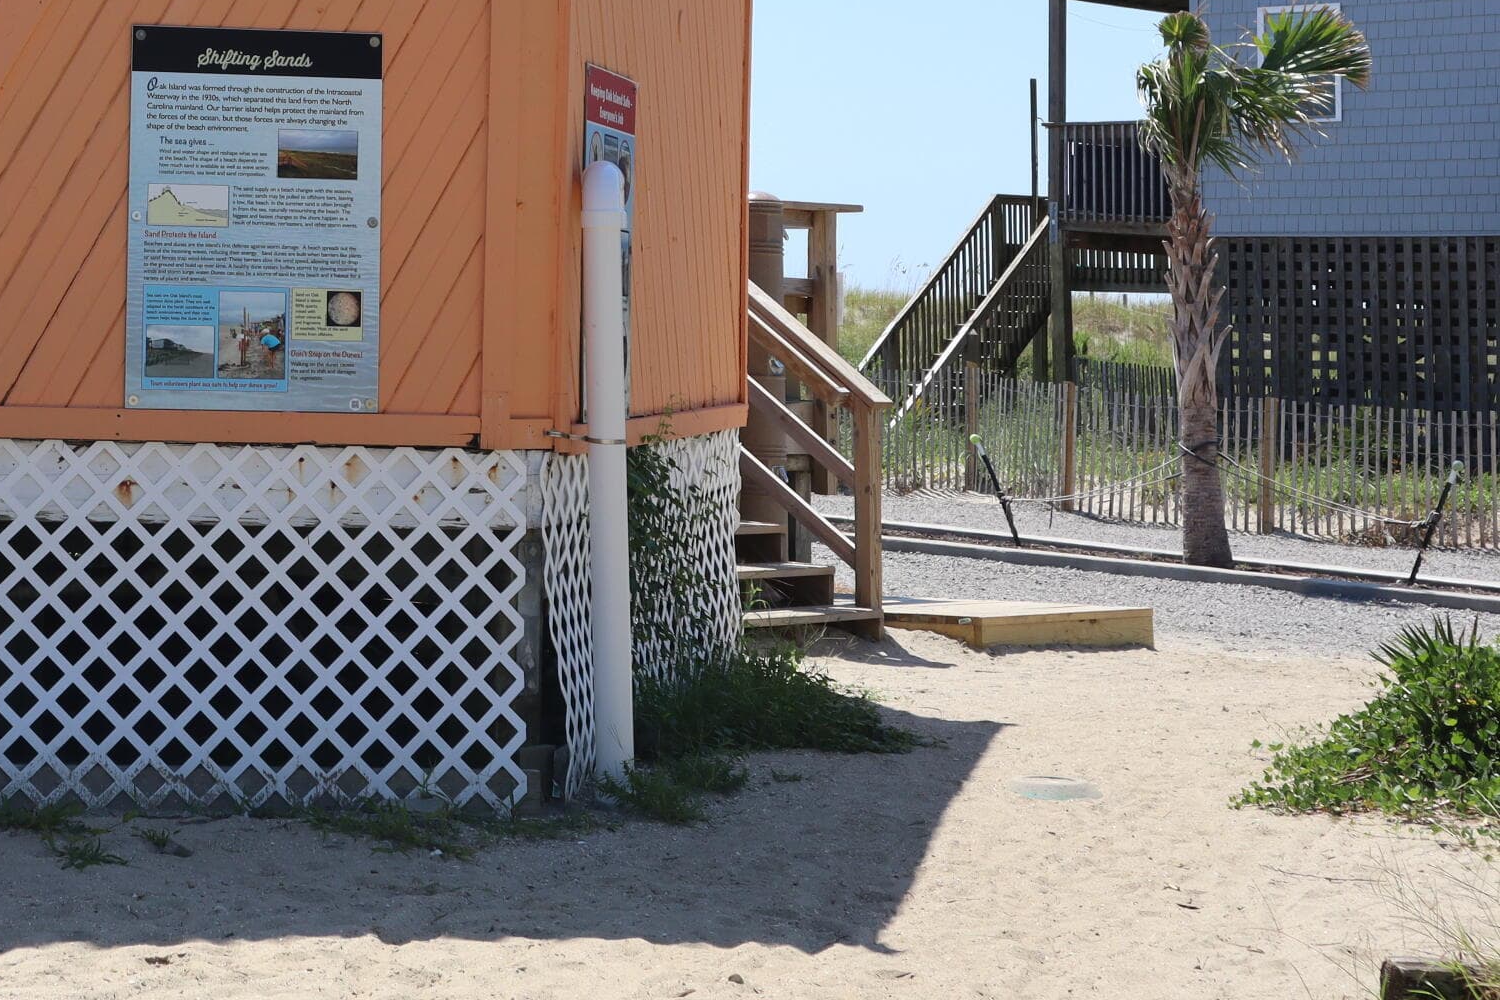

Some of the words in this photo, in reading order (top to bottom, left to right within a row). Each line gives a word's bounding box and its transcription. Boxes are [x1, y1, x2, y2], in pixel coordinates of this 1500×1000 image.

[197, 48, 261, 70] Shifting
[264, 50, 313, 70] Sands
[147, 76, 167, 92] Oak
[168, 82, 187, 90] Island
[202, 83, 226, 92] formed
[228, 84, 252, 94] through
[254, 84, 264, 93] the
[266, 85, 305, 94] construction
[306, 86, 313, 94] of
[314, 86, 325, 94] the
[326, 87, 362, 96] Intracoastal
[147, 92, 180, 103] Waterway
[223, 94, 242, 102] which
[243, 95, 274, 105] separated
[303, 97, 318, 105] from
[332, 97, 352, 106] North
[590, 84, 605, 102] Keeping
[613, 92, 622, 106] Island
[147, 102, 174, 110] Carolina
[175, 103, 204, 111] mainland.
[221, 104, 243, 112] barrier
[245, 105, 263, 113] island
[264, 105, 281, 115] helps
[282, 106, 306, 116] protect
[319, 107, 348, 115] mainland
[349, 108, 364, 116] from
[158, 112, 178, 120] forces
[235, 114, 252, 122] those
[254, 115, 273, 123] forces
[287, 116, 307, 126] always
[309, 116, 336, 126] changing
[147, 122, 165, 132] shape
[160, 136, 173, 145] The
[188, 137, 206, 148] gives
[308, 350, 323, 360] Step
